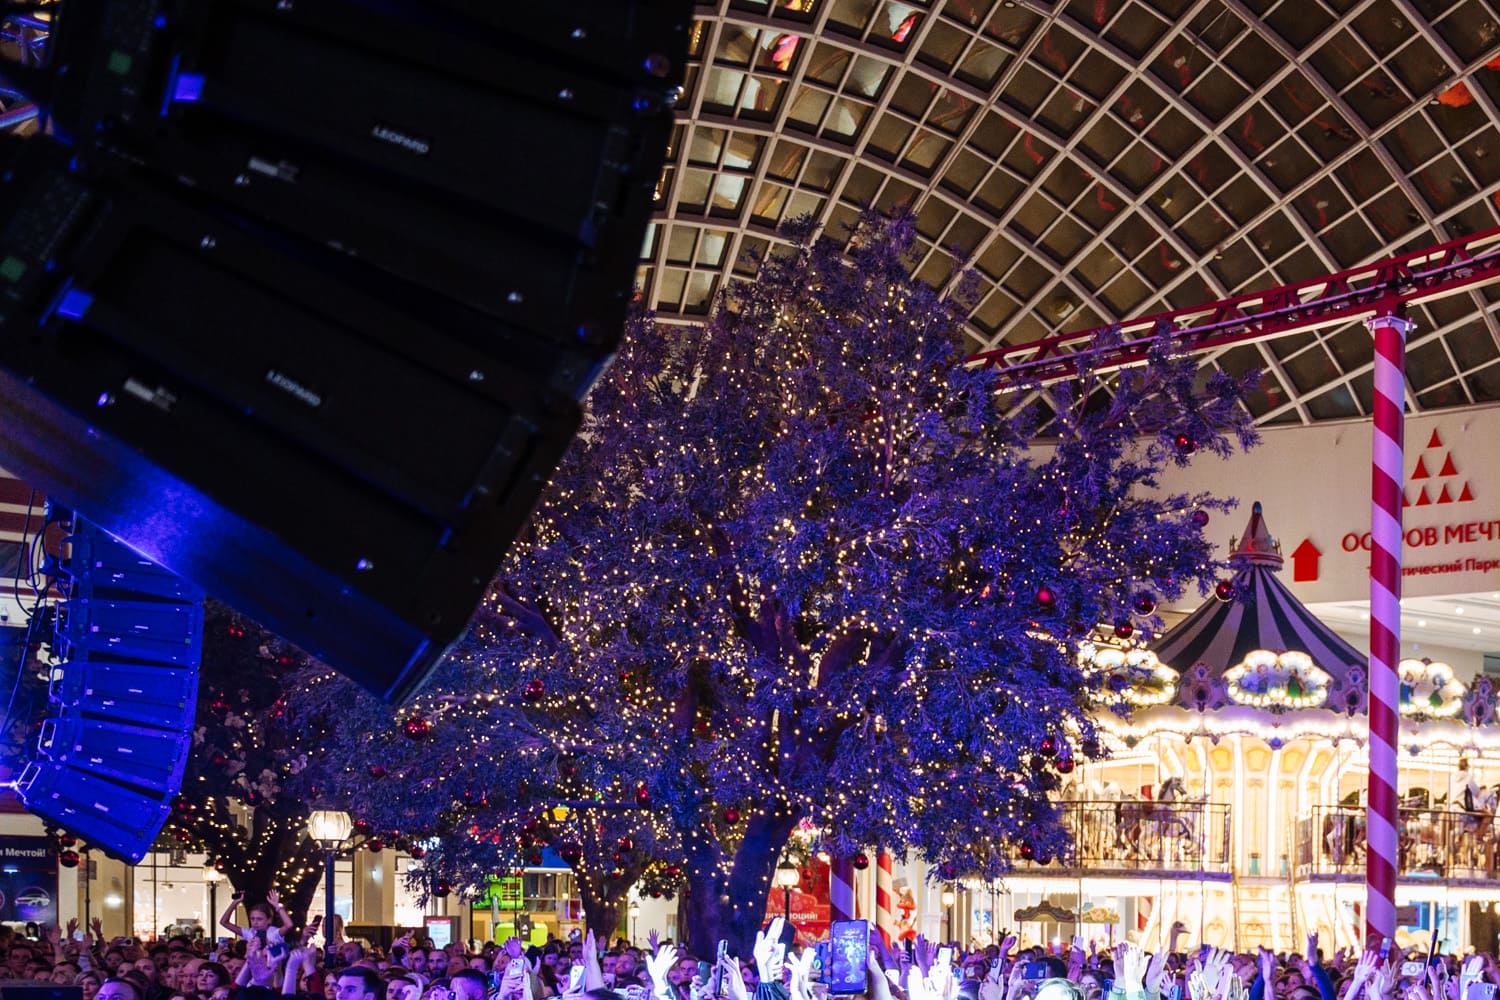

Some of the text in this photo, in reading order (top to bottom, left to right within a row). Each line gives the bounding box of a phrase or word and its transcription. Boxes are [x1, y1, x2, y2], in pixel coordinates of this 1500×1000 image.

[1341, 527, 1438, 552] ОСОВ
[1465, 558, 1500, 573] Парк
[5, 847, 46, 858] Мечтой!
